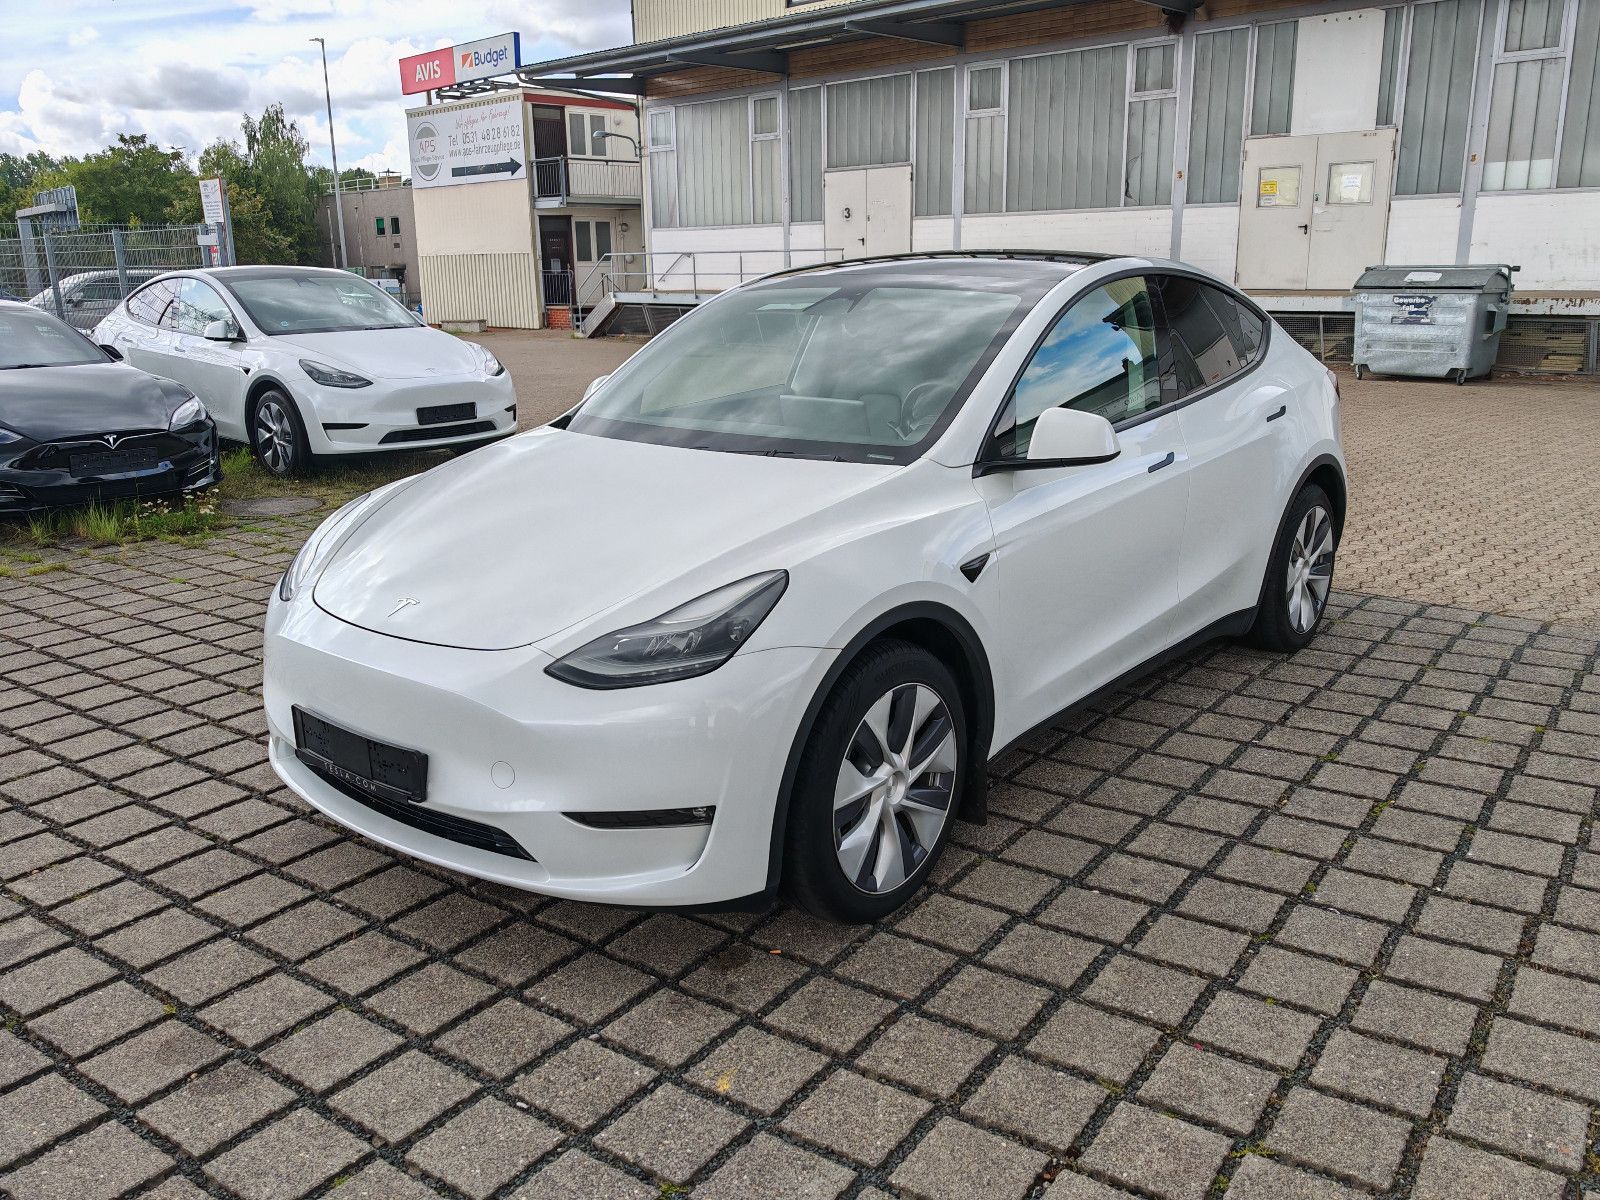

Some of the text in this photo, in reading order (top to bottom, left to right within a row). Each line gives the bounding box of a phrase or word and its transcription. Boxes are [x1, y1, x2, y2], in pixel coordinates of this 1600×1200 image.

[474, 45, 508, 67] Budget
[415, 59, 441, 83] AVIS
[418, 139, 436, 155] APS
[462, 130, 478, 145] 0531
[844, 207, 851, 219] 3
[324, 761, 377, 792] TESLA.COM
